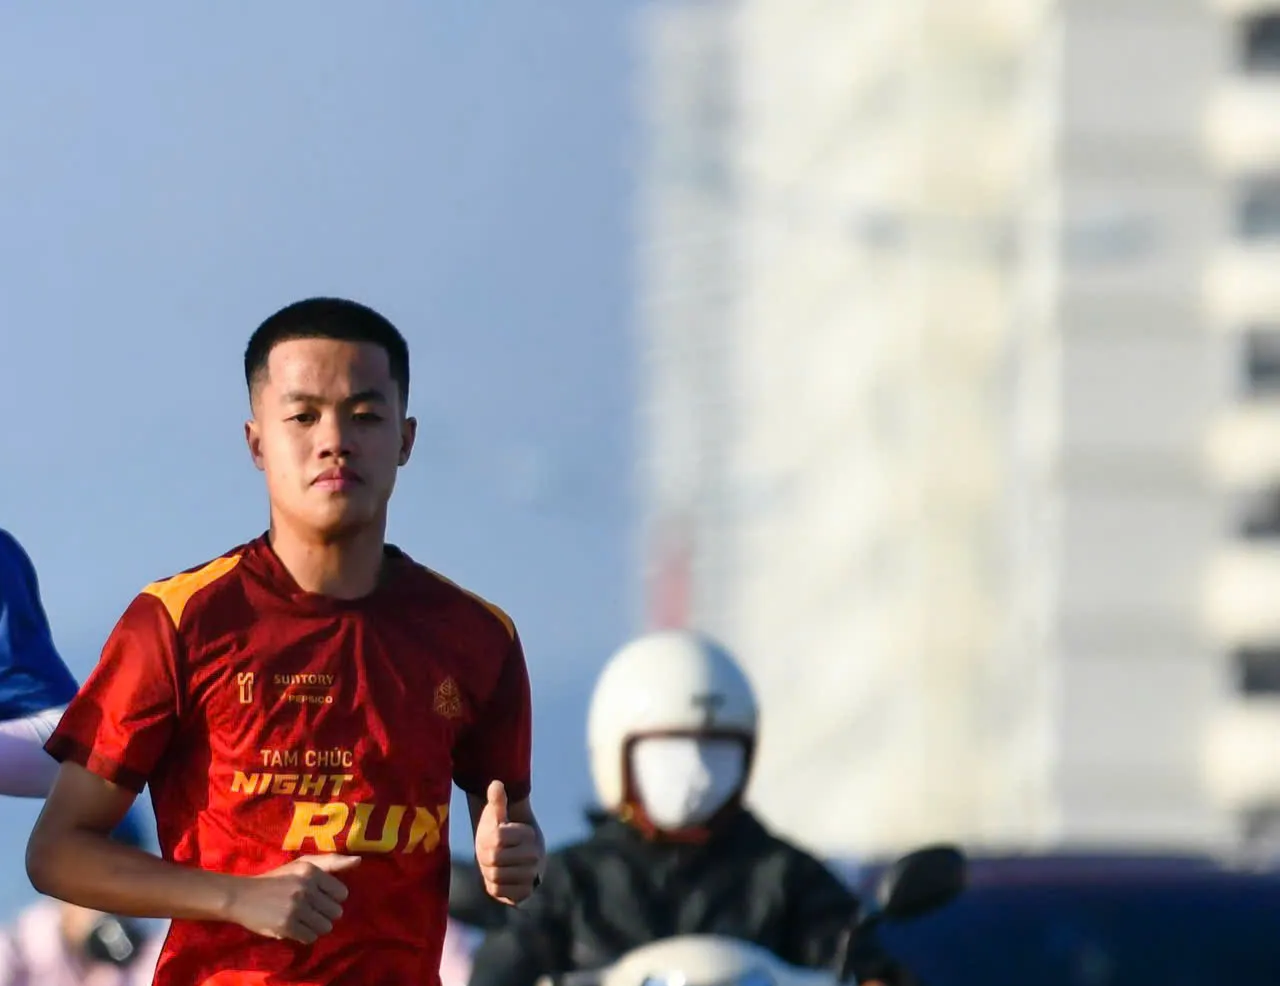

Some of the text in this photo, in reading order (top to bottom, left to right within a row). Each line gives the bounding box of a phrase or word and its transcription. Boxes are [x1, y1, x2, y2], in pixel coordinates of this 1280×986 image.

[273, 673, 334, 685] SUNTORY
[260, 747, 353, 768] TAM CHÚC
[231, 770, 353, 796] NIGHT
[281, 801, 449, 853] RUN
